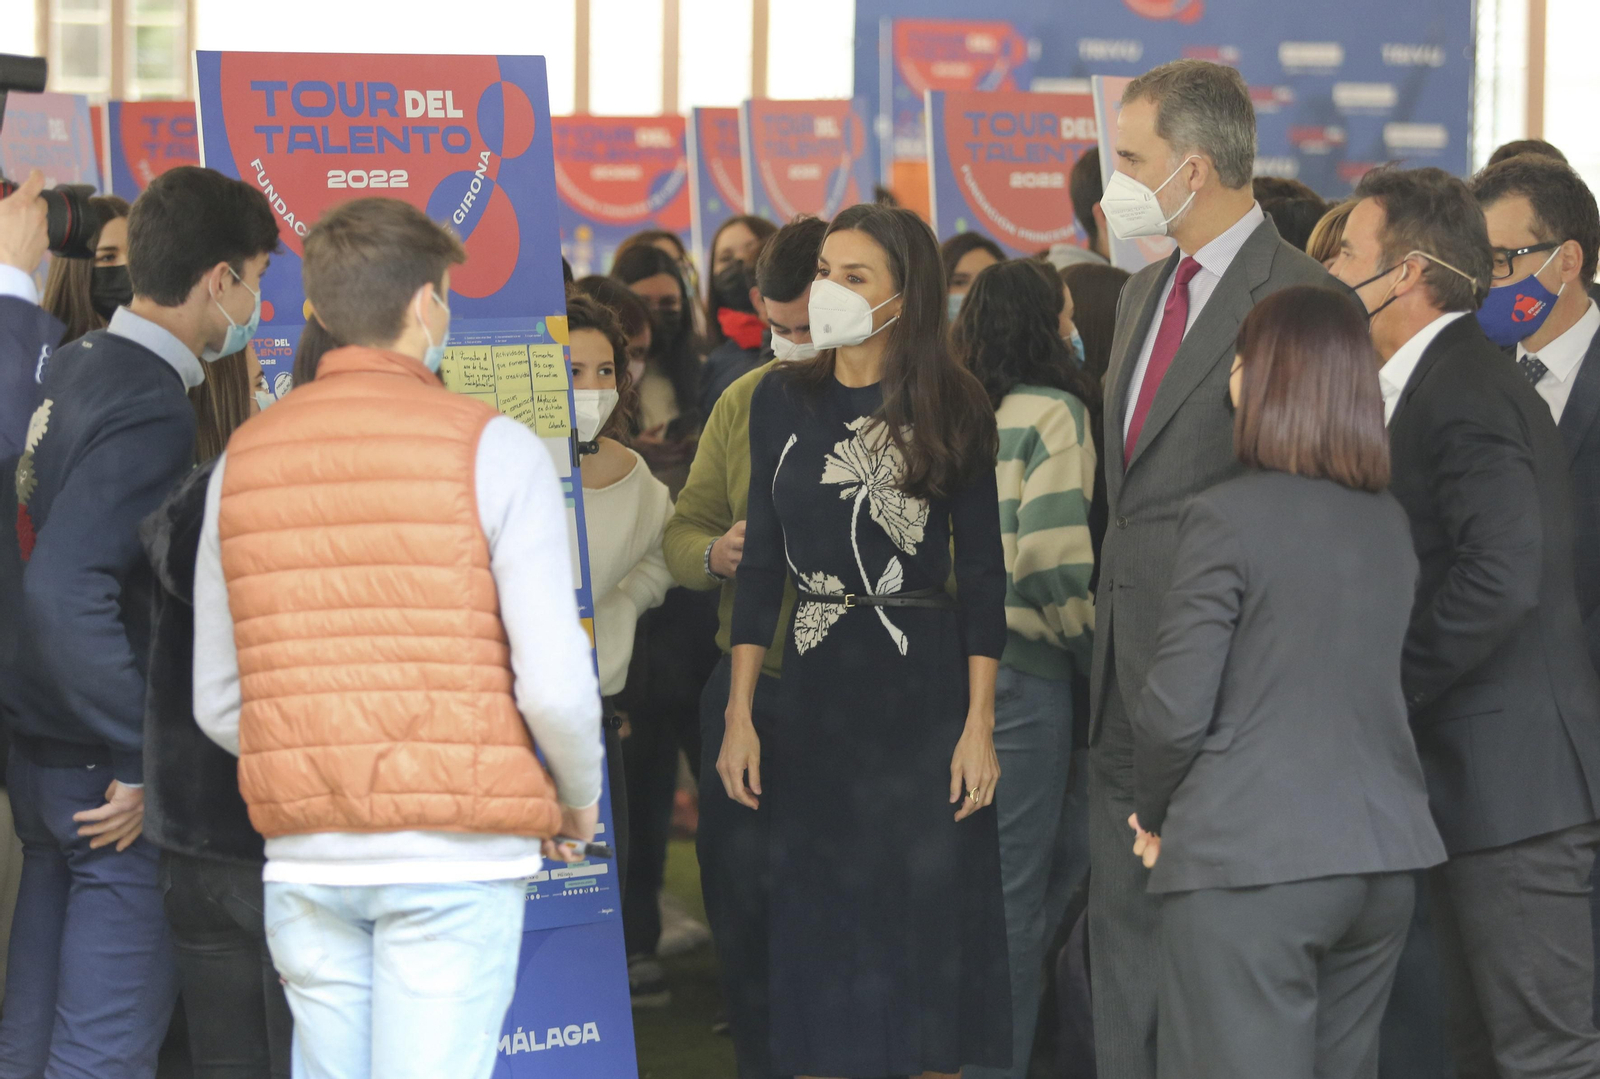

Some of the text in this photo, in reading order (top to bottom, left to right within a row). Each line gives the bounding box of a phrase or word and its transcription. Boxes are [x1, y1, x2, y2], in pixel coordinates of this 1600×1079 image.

[250, 80, 464, 118] TOUR DEL
[141, 115, 198, 138] TO
[963, 111, 1099, 139] TOUR DEL
[254, 125, 472, 154] TALENTO
[963, 142, 1097, 163] TALENT
[327, 169, 409, 188] 2022
[250, 158, 311, 237] FUNDAC
[452, 150, 491, 226] GIRONA
[247, 337, 290, 348] ETO DEL
[255, 347, 293, 357] LENTO
[498, 1021, 601, 1056] MÁLAGA
